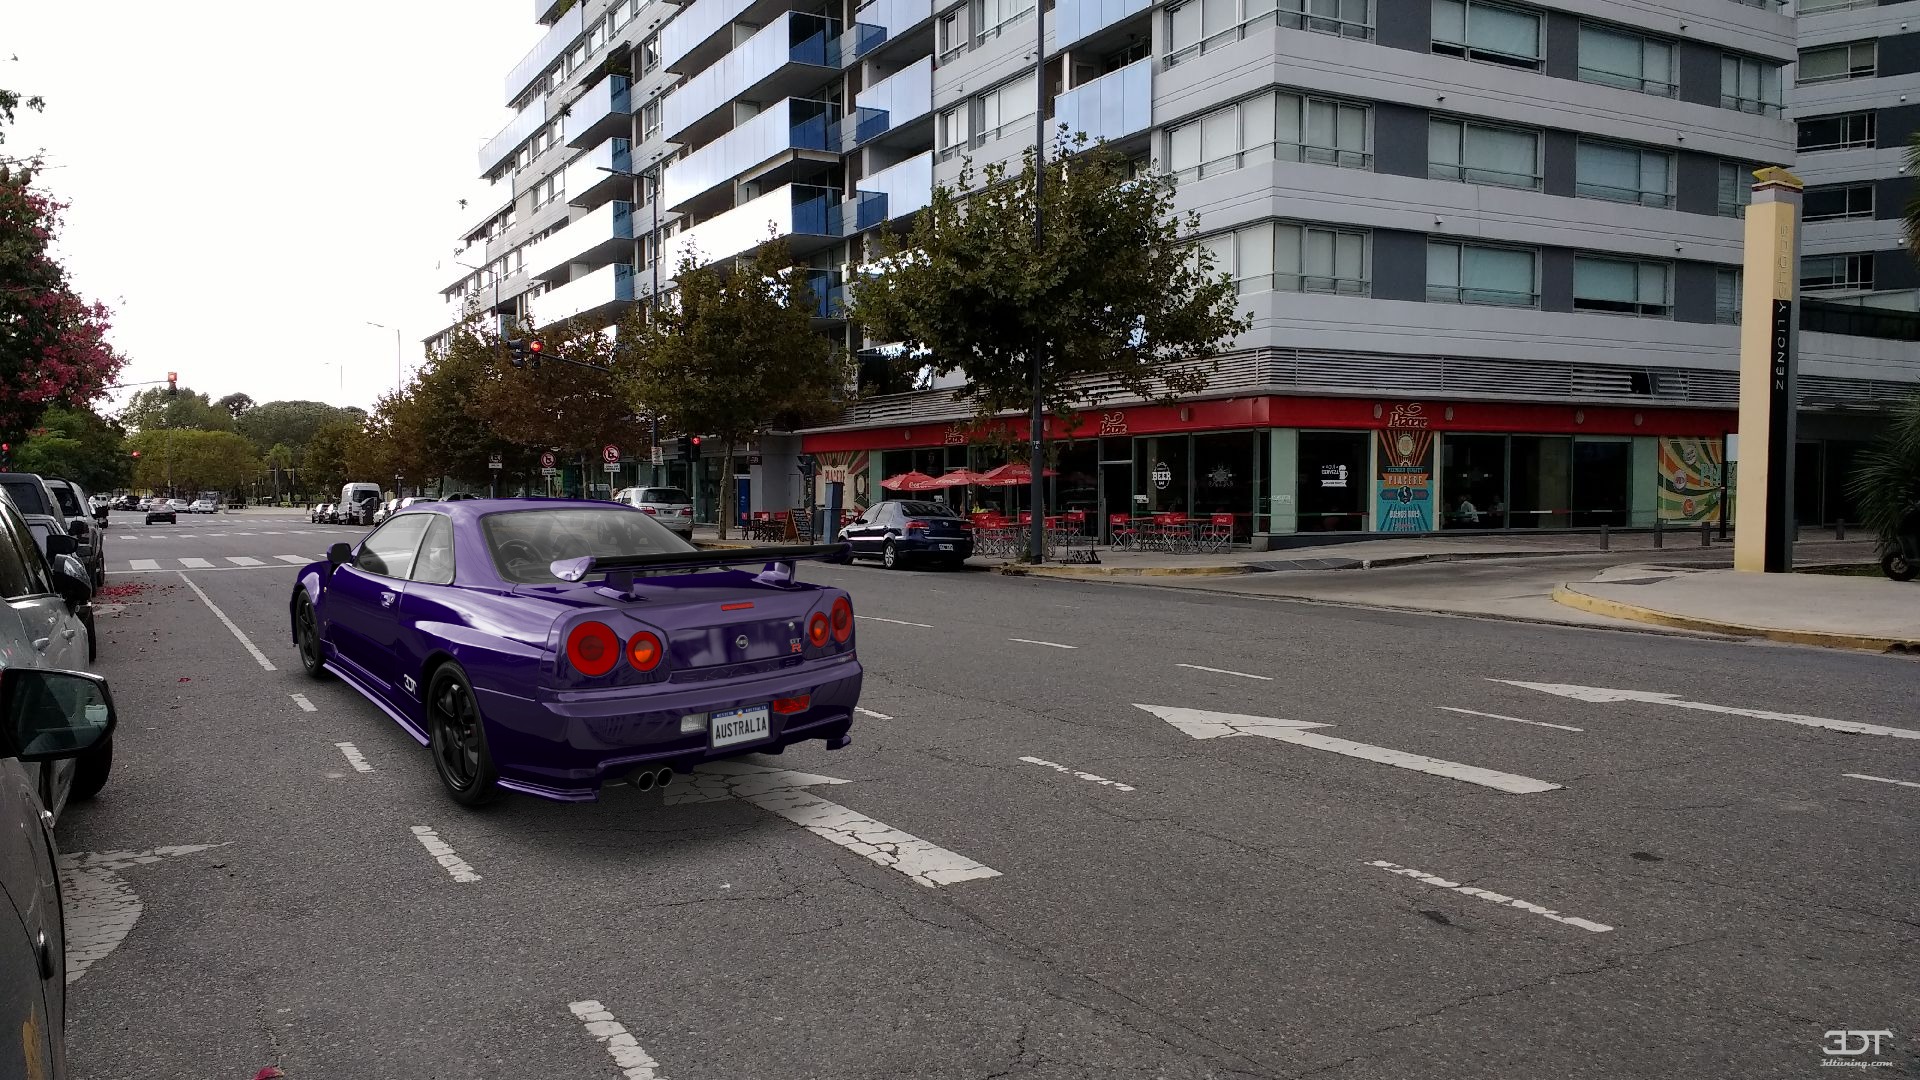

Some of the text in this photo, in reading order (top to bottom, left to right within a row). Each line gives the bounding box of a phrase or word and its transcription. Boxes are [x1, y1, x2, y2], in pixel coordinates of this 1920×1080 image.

[1775, 300, 1787, 391] ZENCITY
[1152, 471, 1171, 480] BEER
[715, 716, 768, 740] AUSTRALIA
